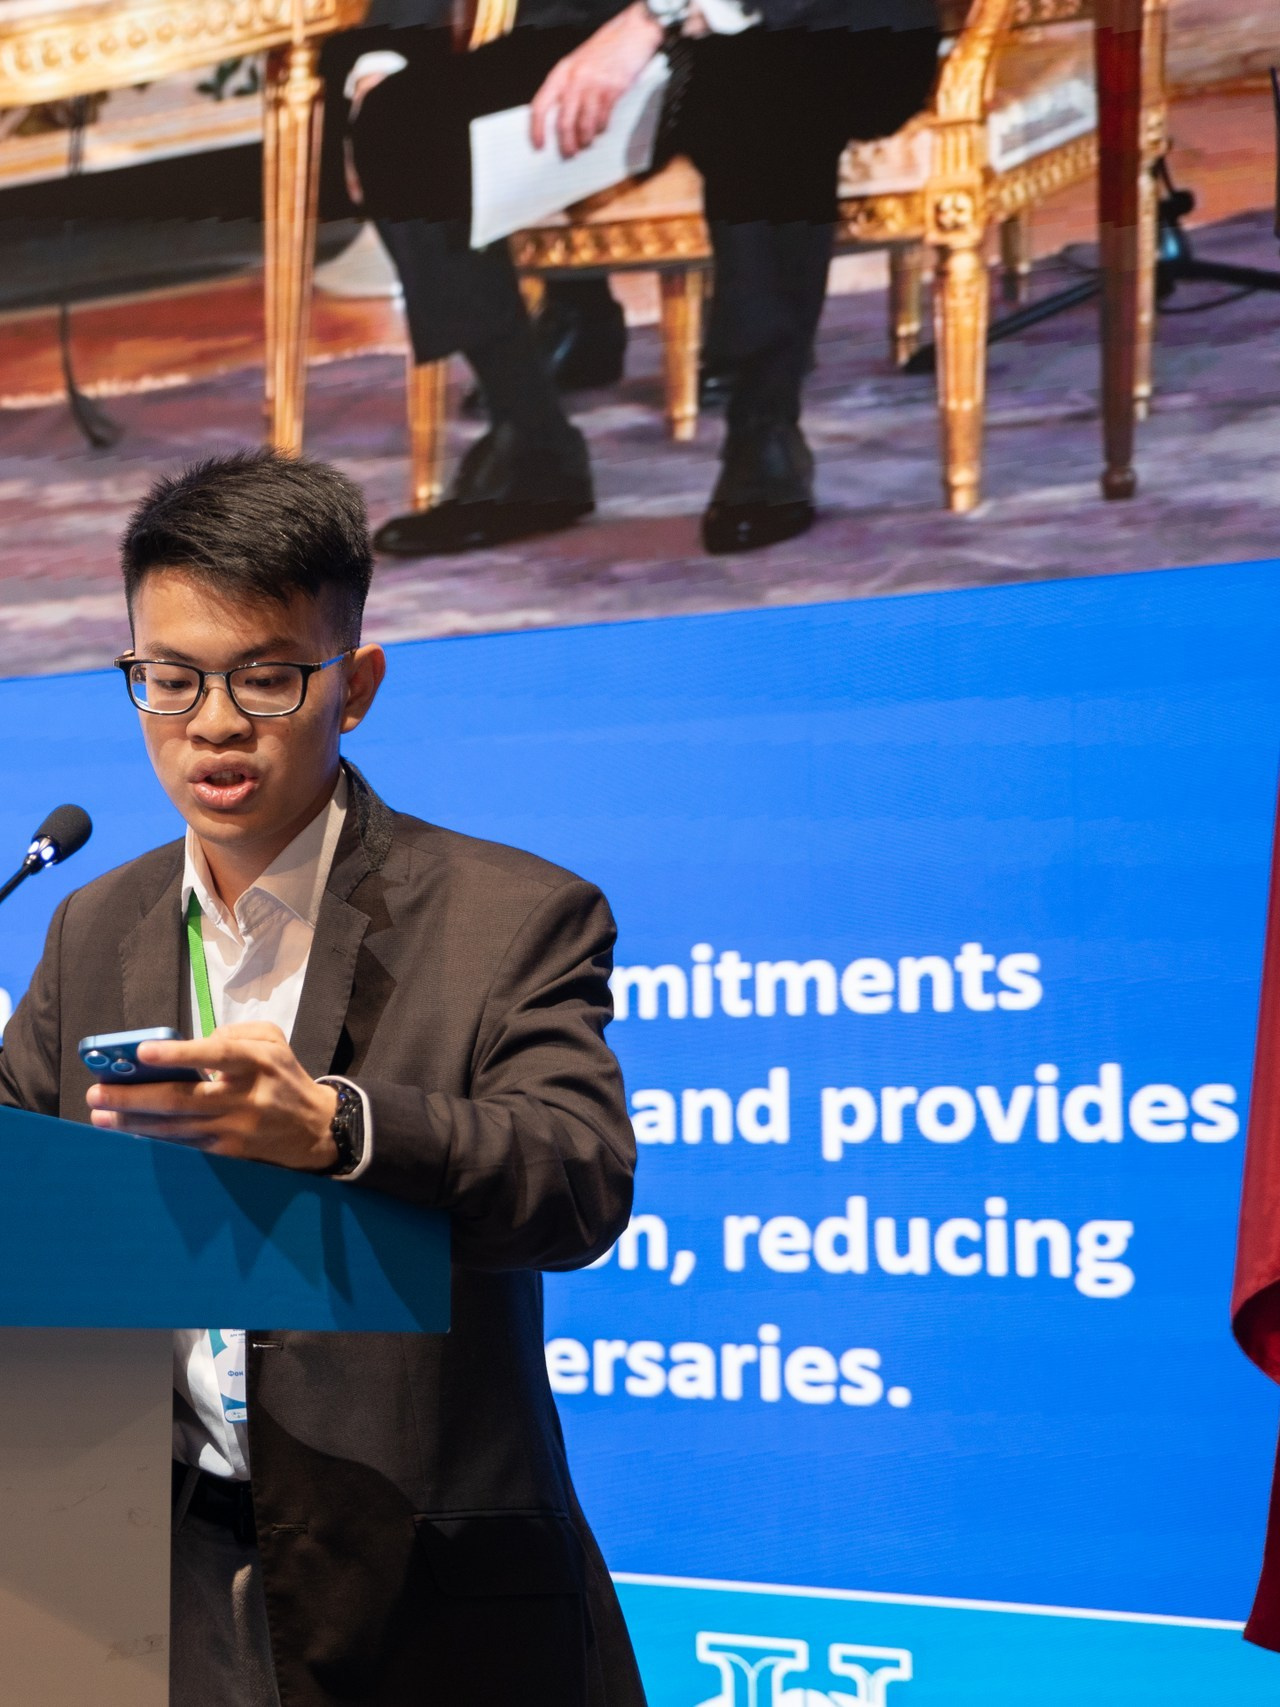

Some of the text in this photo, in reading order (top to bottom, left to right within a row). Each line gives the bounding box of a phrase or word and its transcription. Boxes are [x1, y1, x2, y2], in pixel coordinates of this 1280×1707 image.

[613, 943, 1043, 1020] mitments
[630, 1063, 1239, 1161] and provides
[586, 1196, 1134, 1298] n, reducing
[545, 1323, 911, 1407] ersaries.
